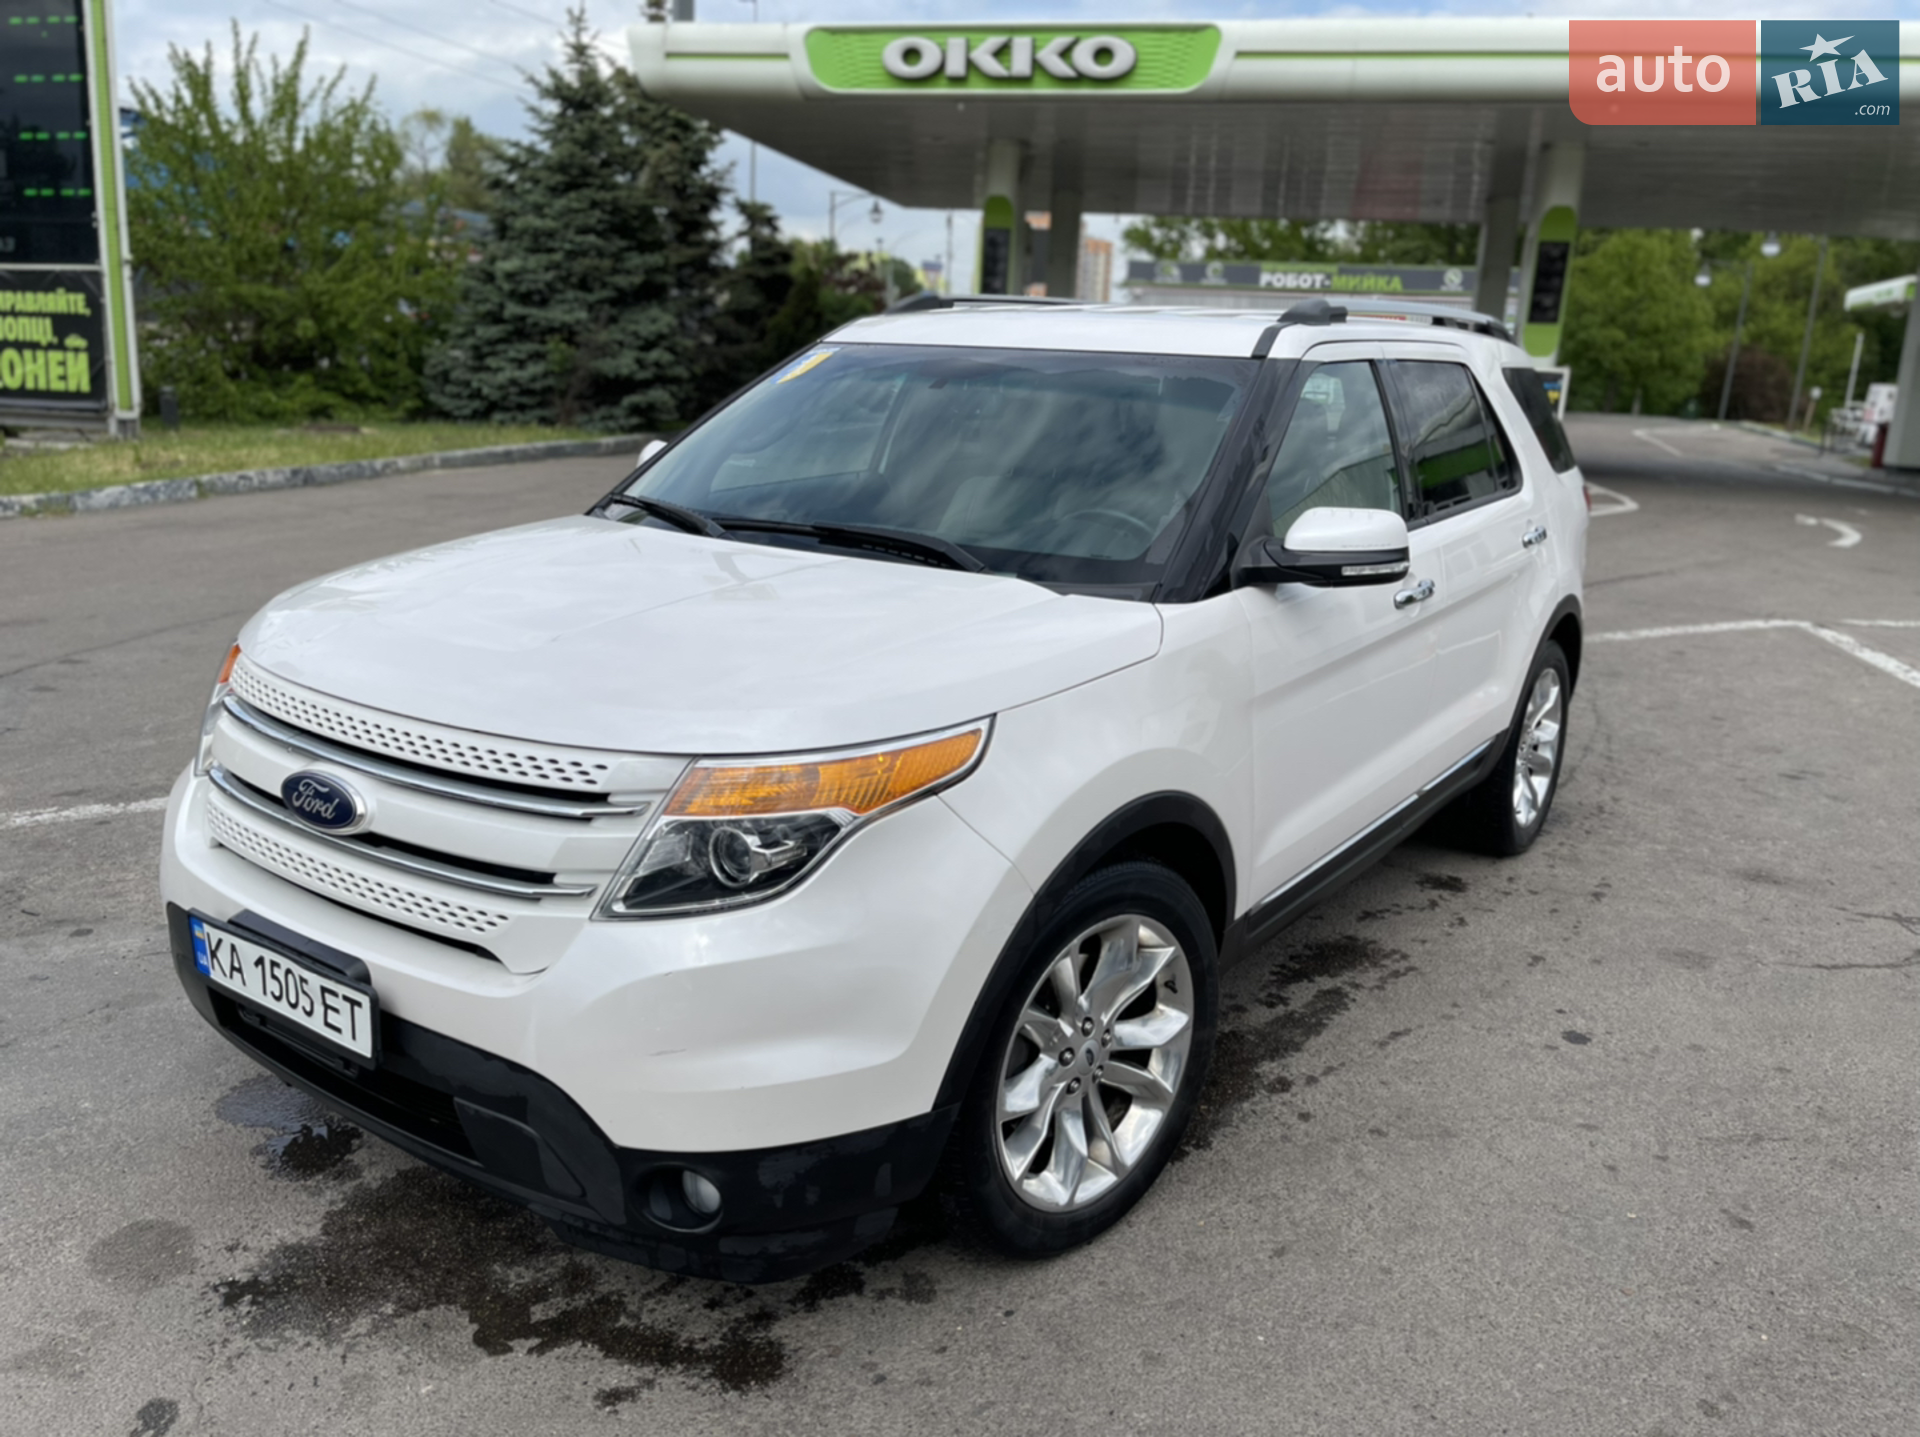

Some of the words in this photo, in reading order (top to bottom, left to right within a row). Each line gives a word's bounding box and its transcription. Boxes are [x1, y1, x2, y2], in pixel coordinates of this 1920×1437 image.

[881, 36, 1137, 79] OKKO
[0, 346, 91, 393] ОНЕЙ
[292, 779, 340, 820] Ford
[206, 931, 247, 987] KA
[253, 955, 316, 1018] 1505
[320, 984, 363, 1042] ET
